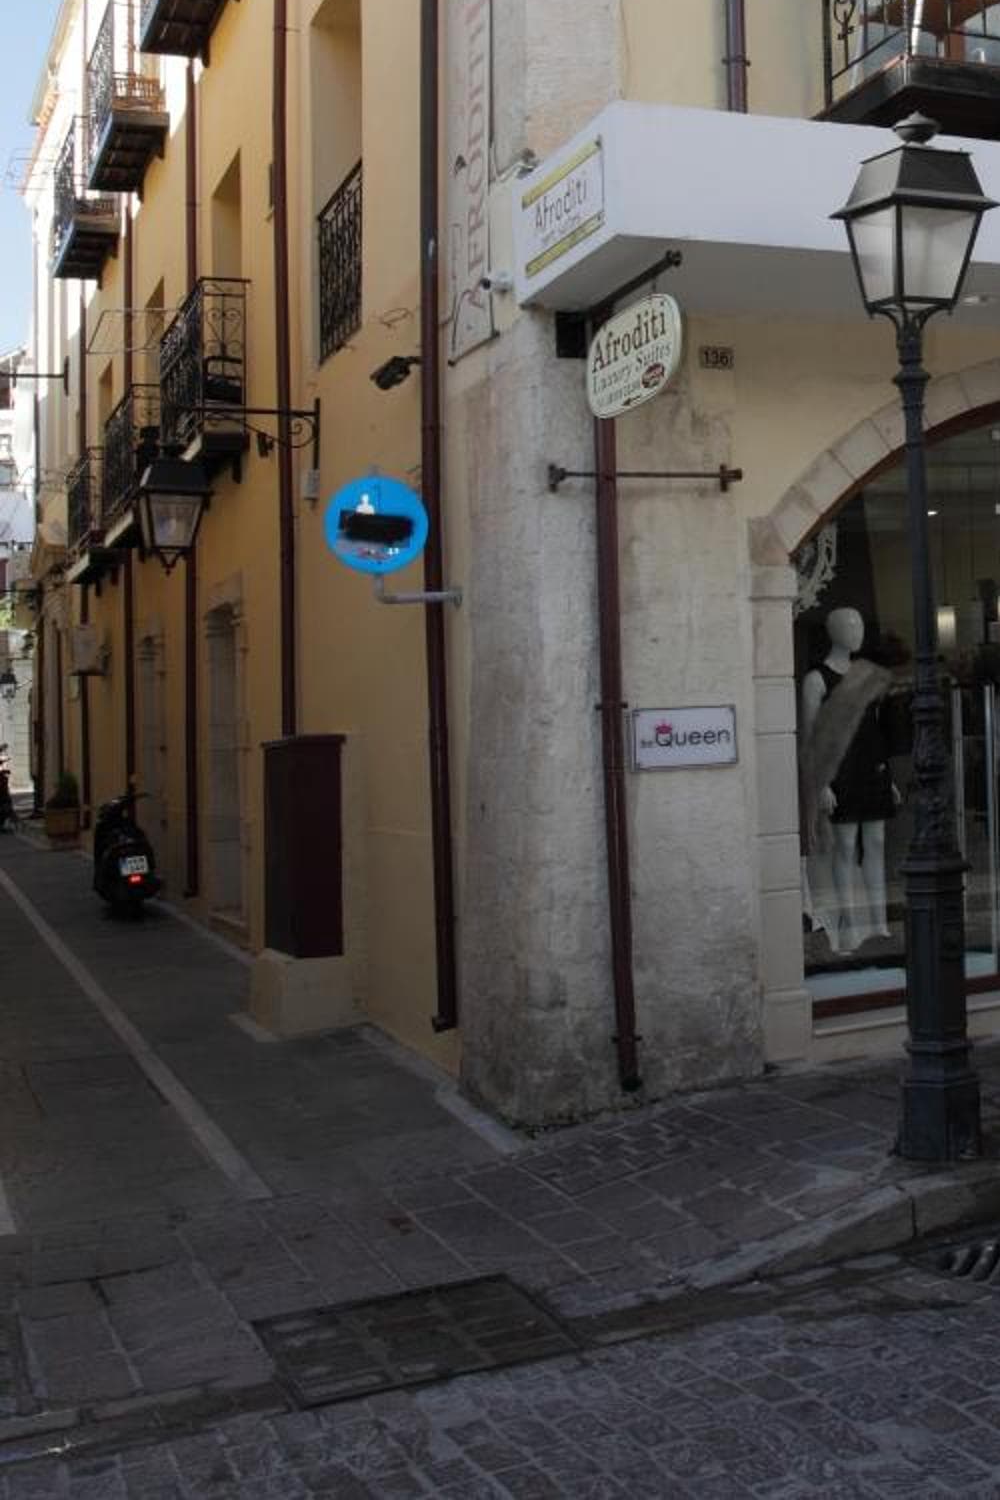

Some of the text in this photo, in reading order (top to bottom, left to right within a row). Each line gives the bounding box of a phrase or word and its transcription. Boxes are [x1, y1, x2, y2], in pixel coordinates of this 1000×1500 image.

[535, 170, 588, 229] Afroditi
[592, 301, 666, 374] Afroditi
[656, 726, 730, 748] Queen
